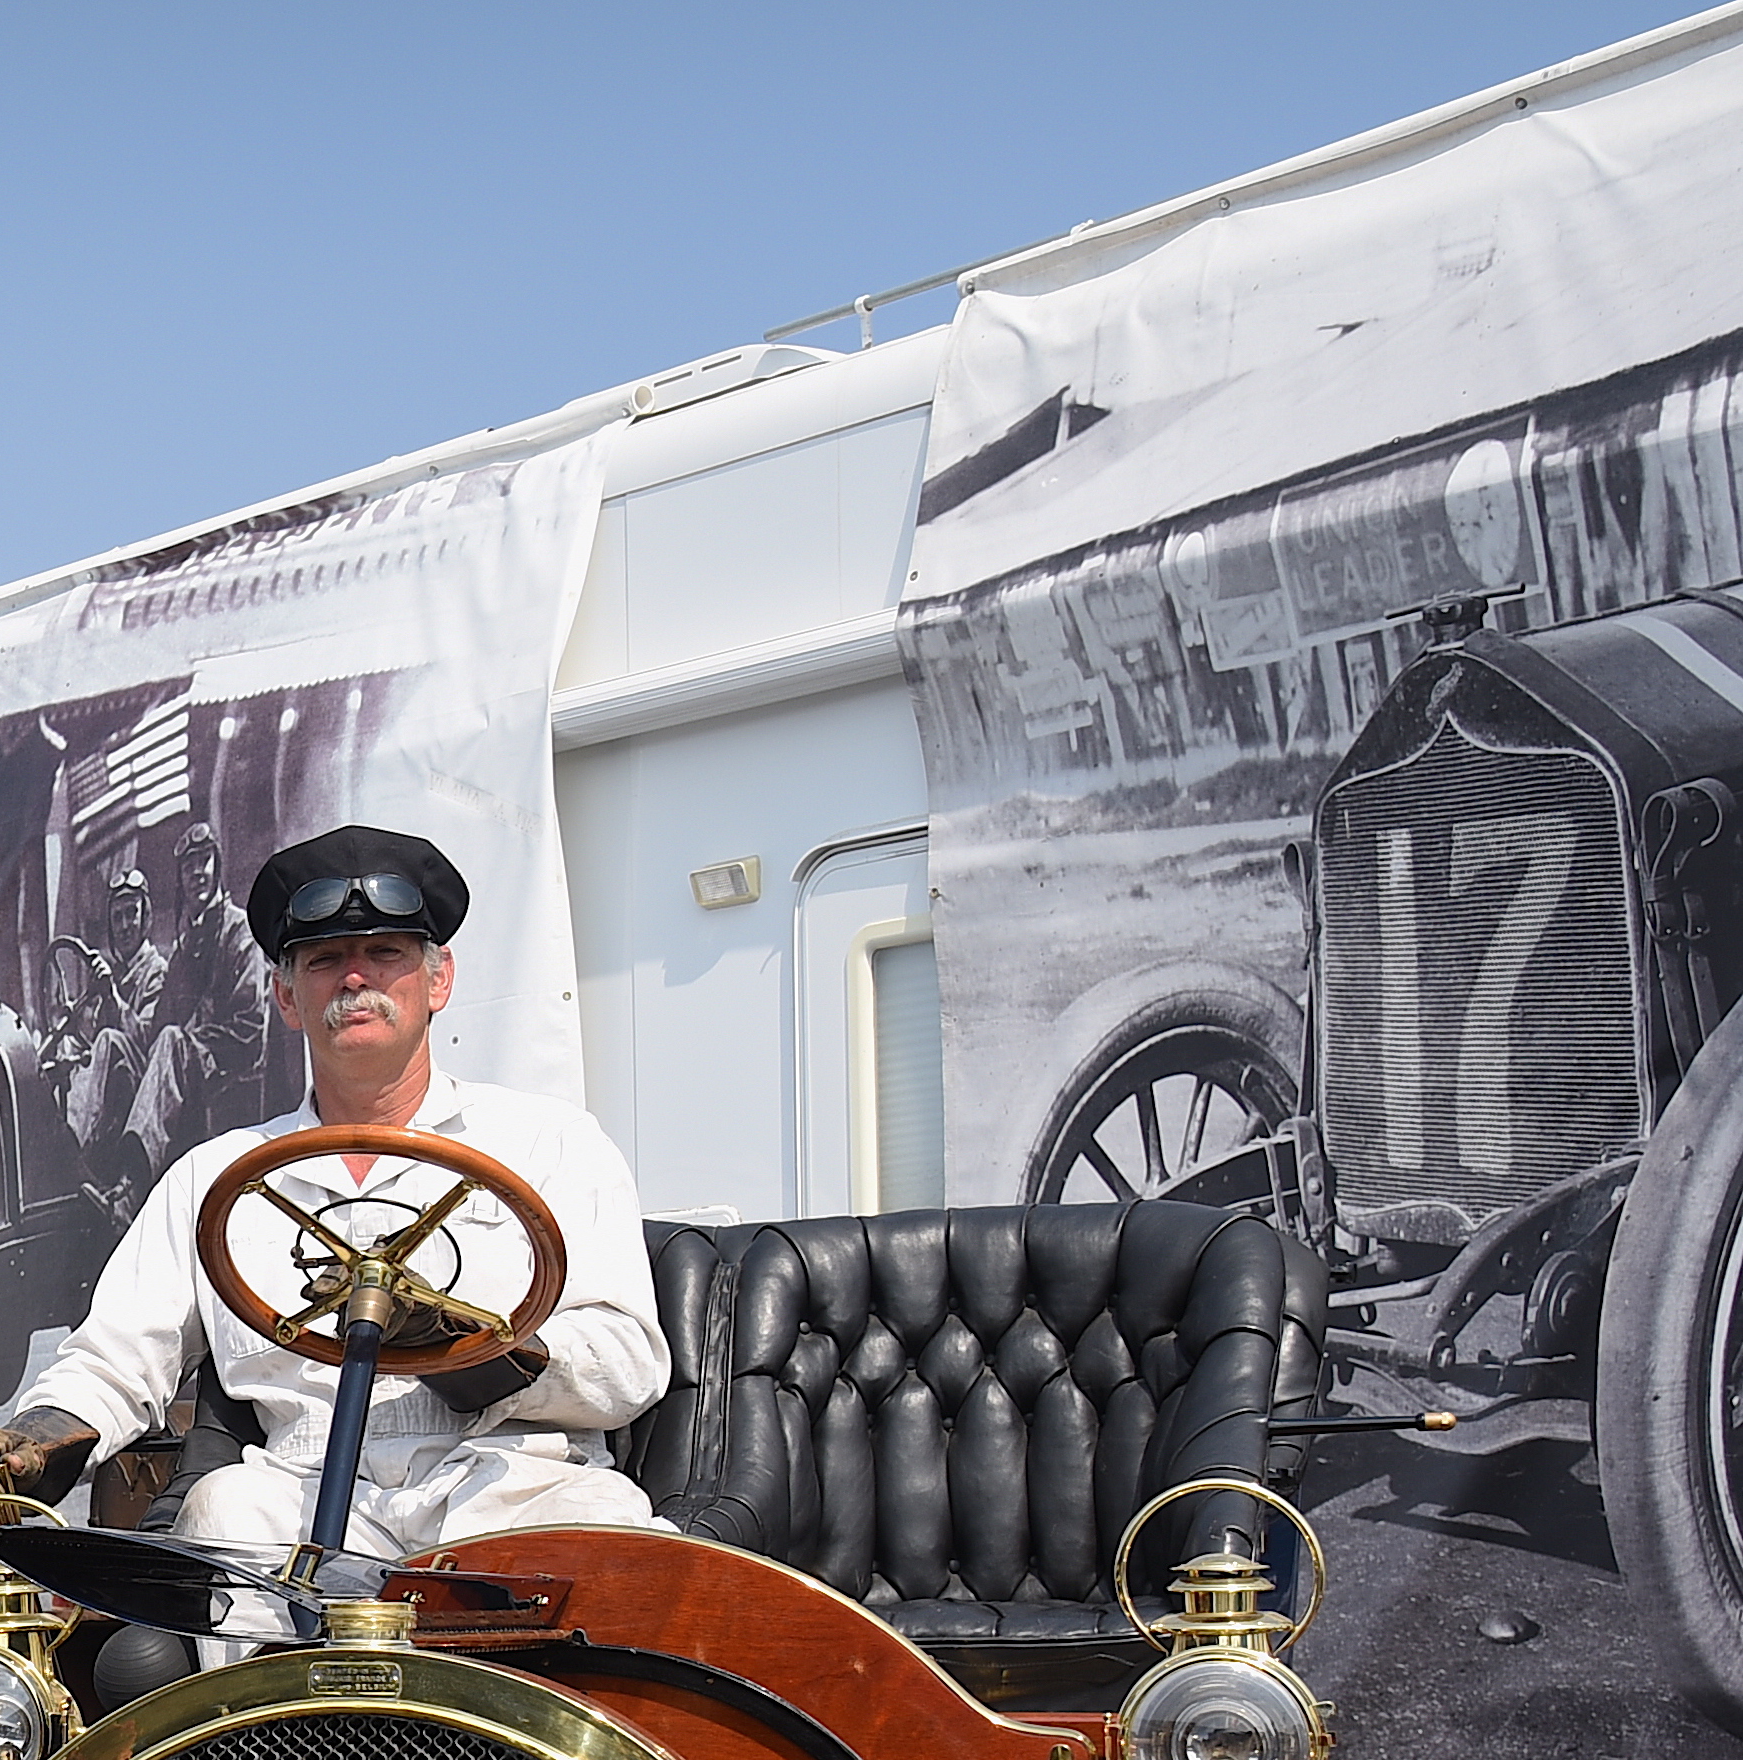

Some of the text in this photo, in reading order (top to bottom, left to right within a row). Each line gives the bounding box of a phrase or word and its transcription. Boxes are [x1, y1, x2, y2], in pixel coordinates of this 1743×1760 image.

[1297, 486, 1422, 553] UNION
[1292, 532, 1450, 612] LEADER
[1376, 809, 1581, 1174] 17
